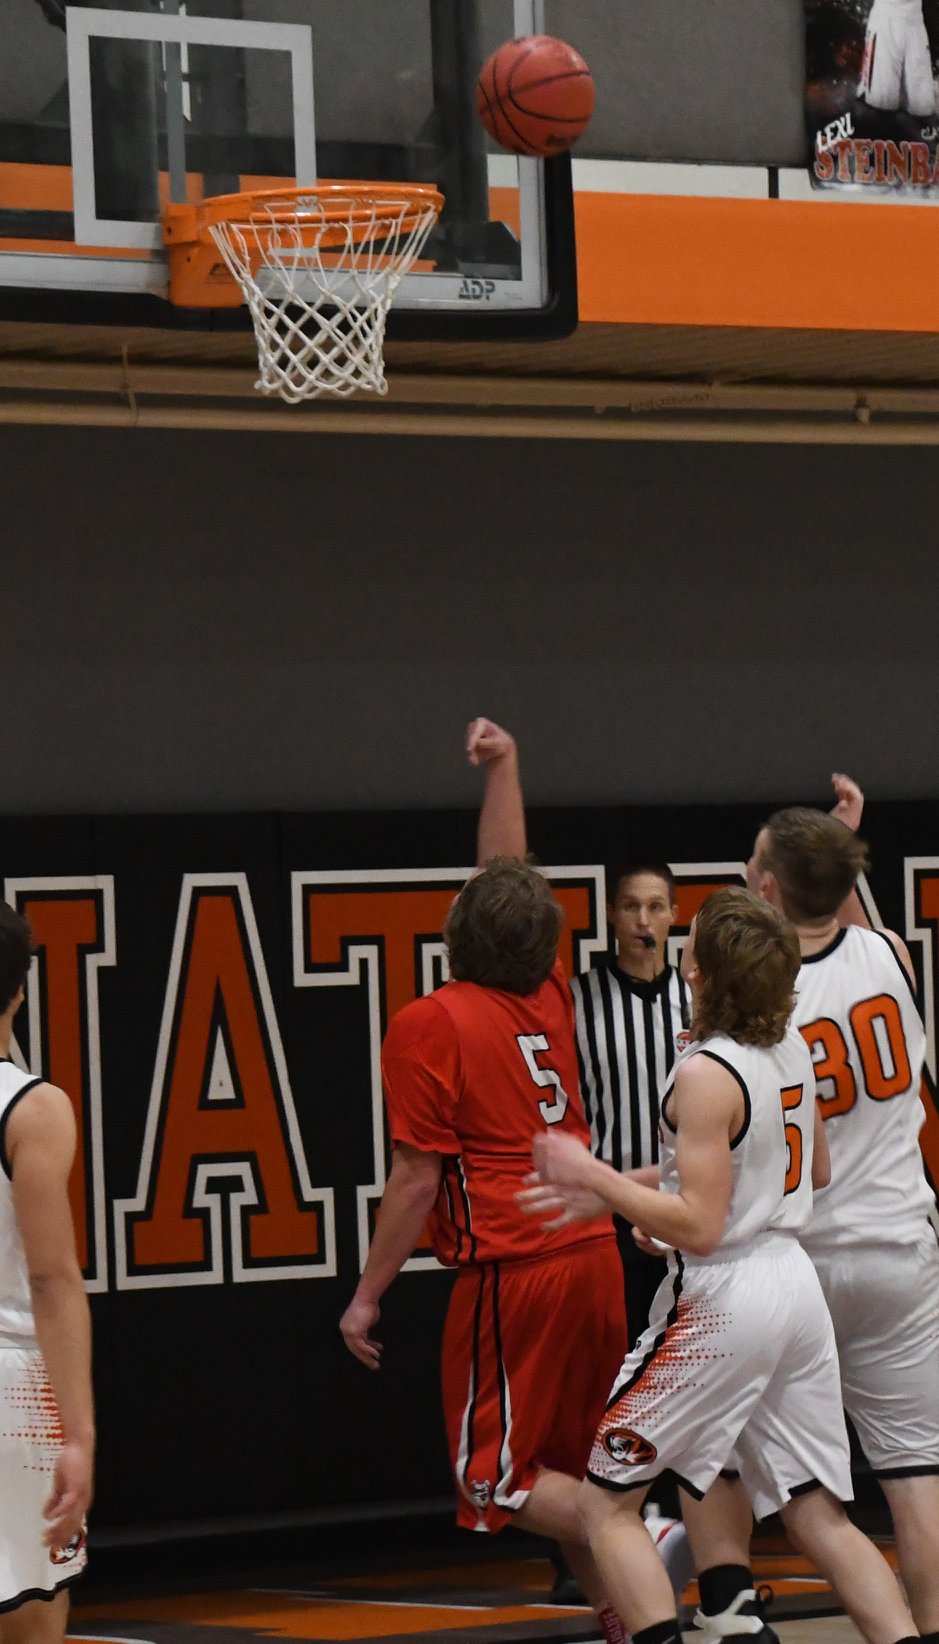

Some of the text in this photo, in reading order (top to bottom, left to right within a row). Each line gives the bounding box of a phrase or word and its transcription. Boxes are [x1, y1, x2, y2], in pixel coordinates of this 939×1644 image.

[814, 138, 939, 186] STEINB
[816, 112, 855, 152] LEXI
[515, 1032, 569, 1126] 5
[799, 993, 912, 1121] 30
[779, 1083, 804, 1196] 5
